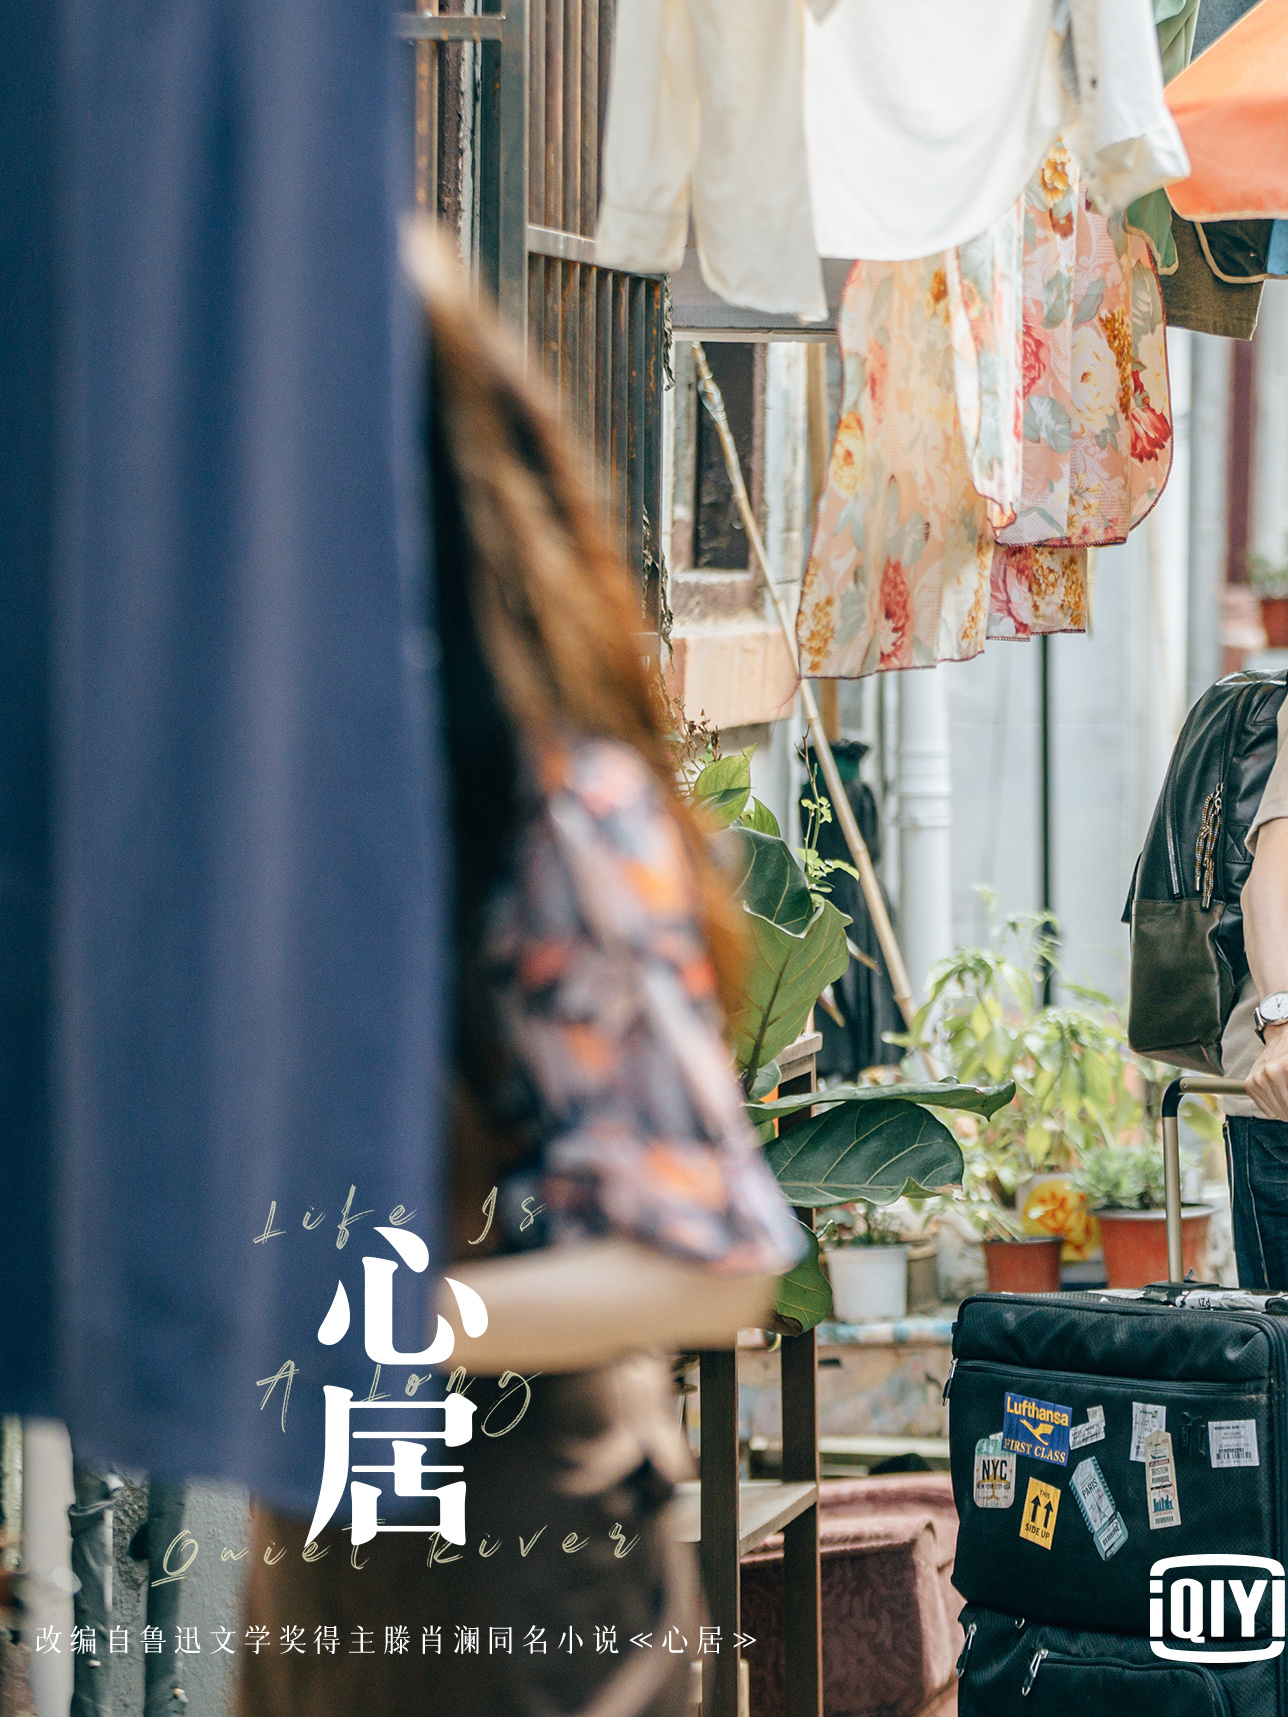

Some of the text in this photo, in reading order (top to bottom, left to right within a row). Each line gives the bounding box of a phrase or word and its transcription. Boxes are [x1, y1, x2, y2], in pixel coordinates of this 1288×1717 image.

[1006, 1396, 1069, 1427] Lufthansa
[1003, 1438, 1067, 1463] FIRST CLASS
[982, 1459, 1008, 1481] NYC
[1151, 1465, 1169, 1477] BOSTON
[1039, 1489, 1051, 1499] THIS
[1081, 1477, 1099, 1500] PARIS
[1025, 1523, 1051, 1540] SIDE UP
